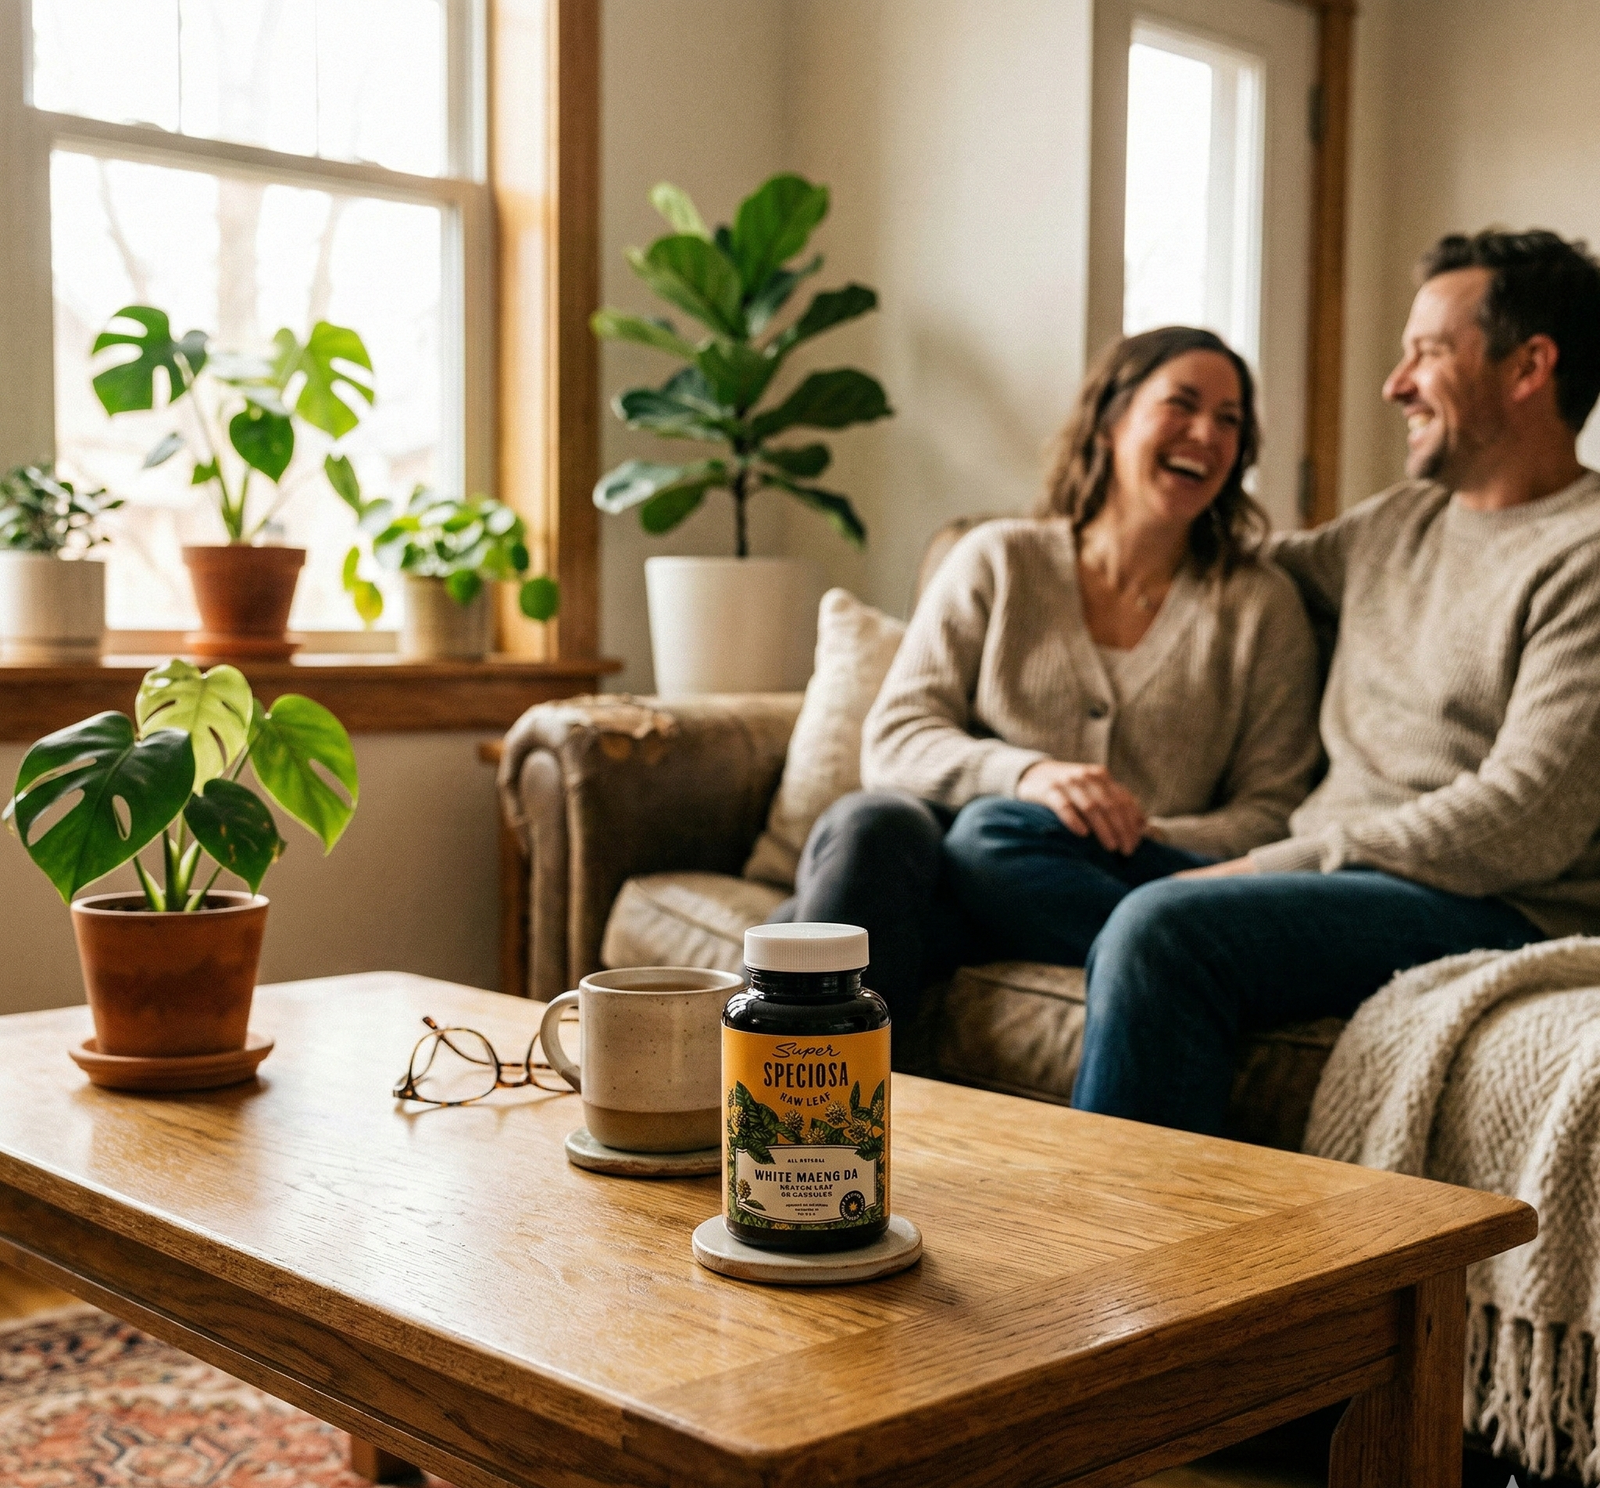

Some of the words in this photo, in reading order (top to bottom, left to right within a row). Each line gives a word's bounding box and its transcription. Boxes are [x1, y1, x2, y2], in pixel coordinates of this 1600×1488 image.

[772, 1042, 841, 1059] Super
[763, 1061, 848, 1088] SPECIOSA
[807, 1091, 831, 1107] LEAF
[755, 1169, 792, 1183] WHITE
[796, 1170, 840, 1183] MAENG
[844, 1168, 858, 1181] DA
